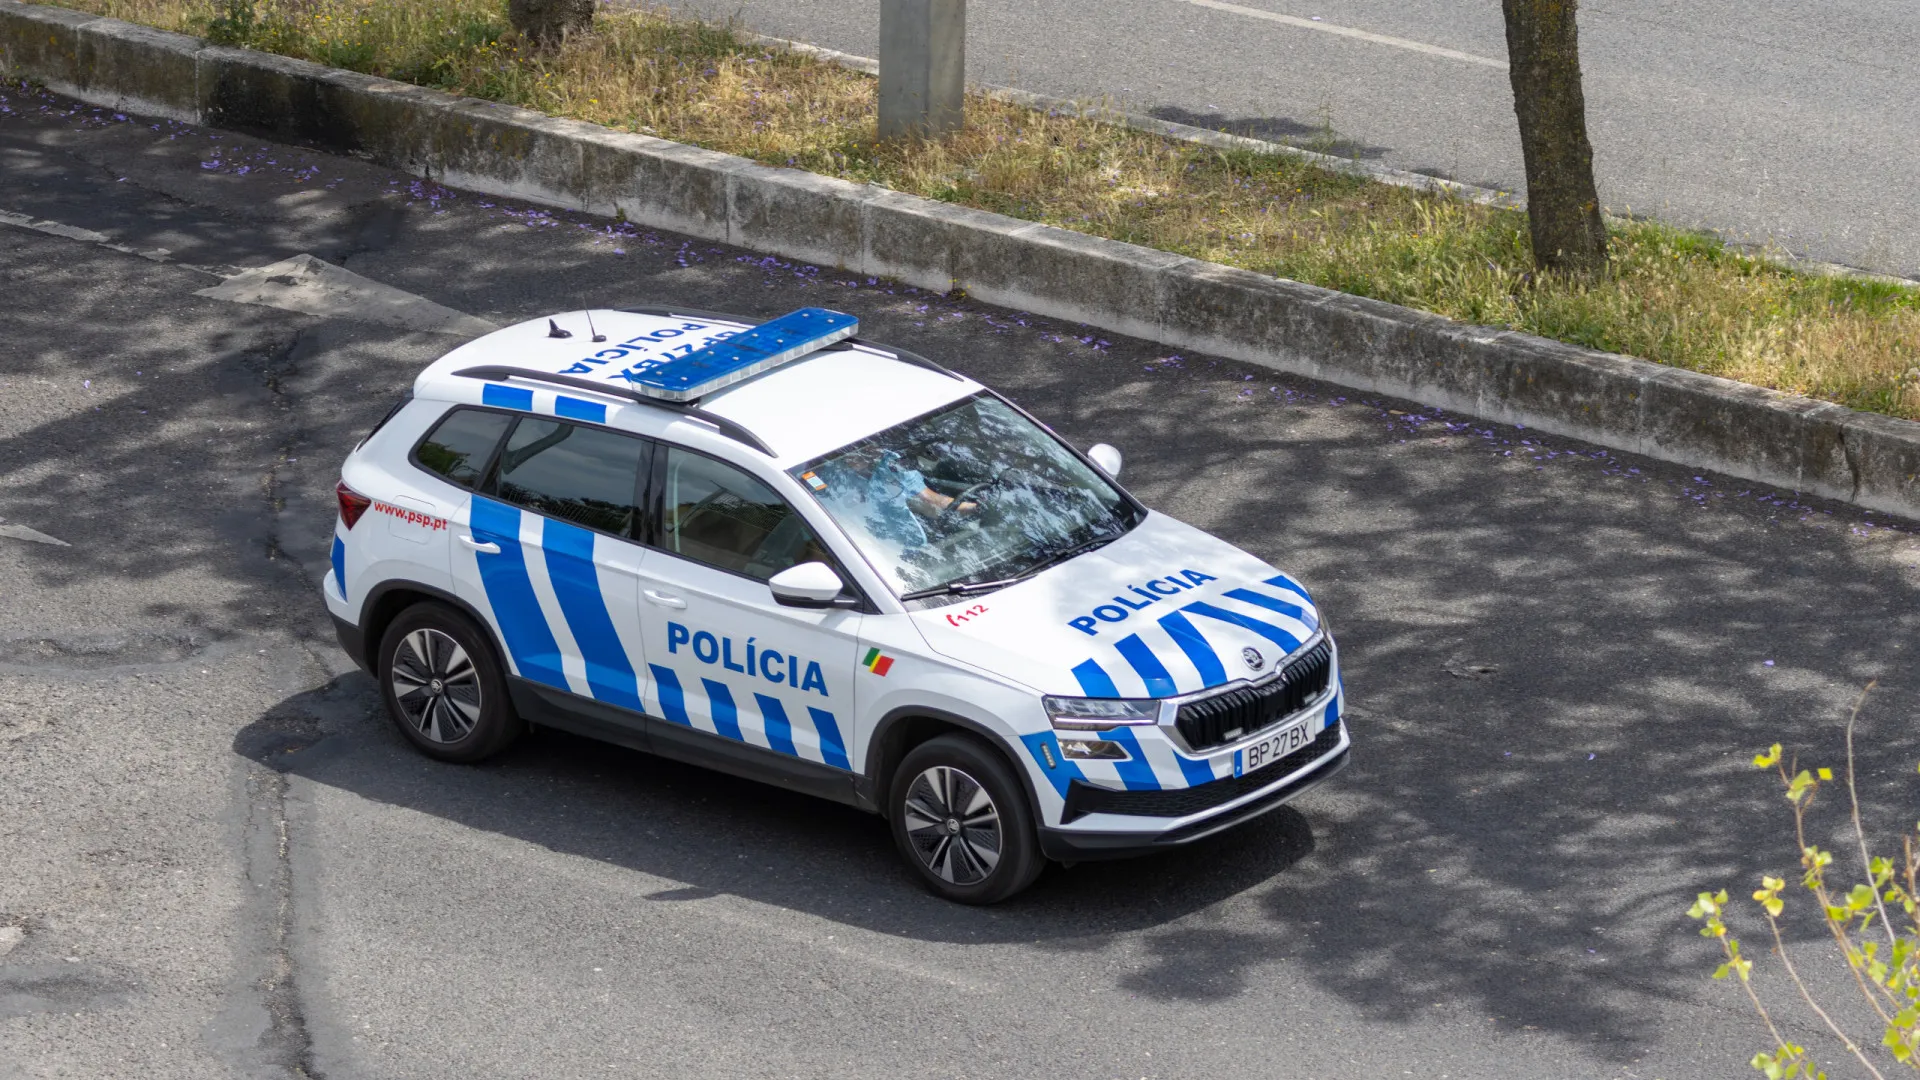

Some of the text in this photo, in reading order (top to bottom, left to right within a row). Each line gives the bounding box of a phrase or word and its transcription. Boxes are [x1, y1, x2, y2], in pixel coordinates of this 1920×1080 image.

[558, 323, 709, 374] POLÍCIA
[374, 502, 447, 530] www.psp.pt
[957, 605, 989, 622] 112
[1067, 569, 1218, 636] POLÍCIA
[667, 621, 829, 697] POLÍCIA
[1248, 721, 1309, 768] BP 27 BX
